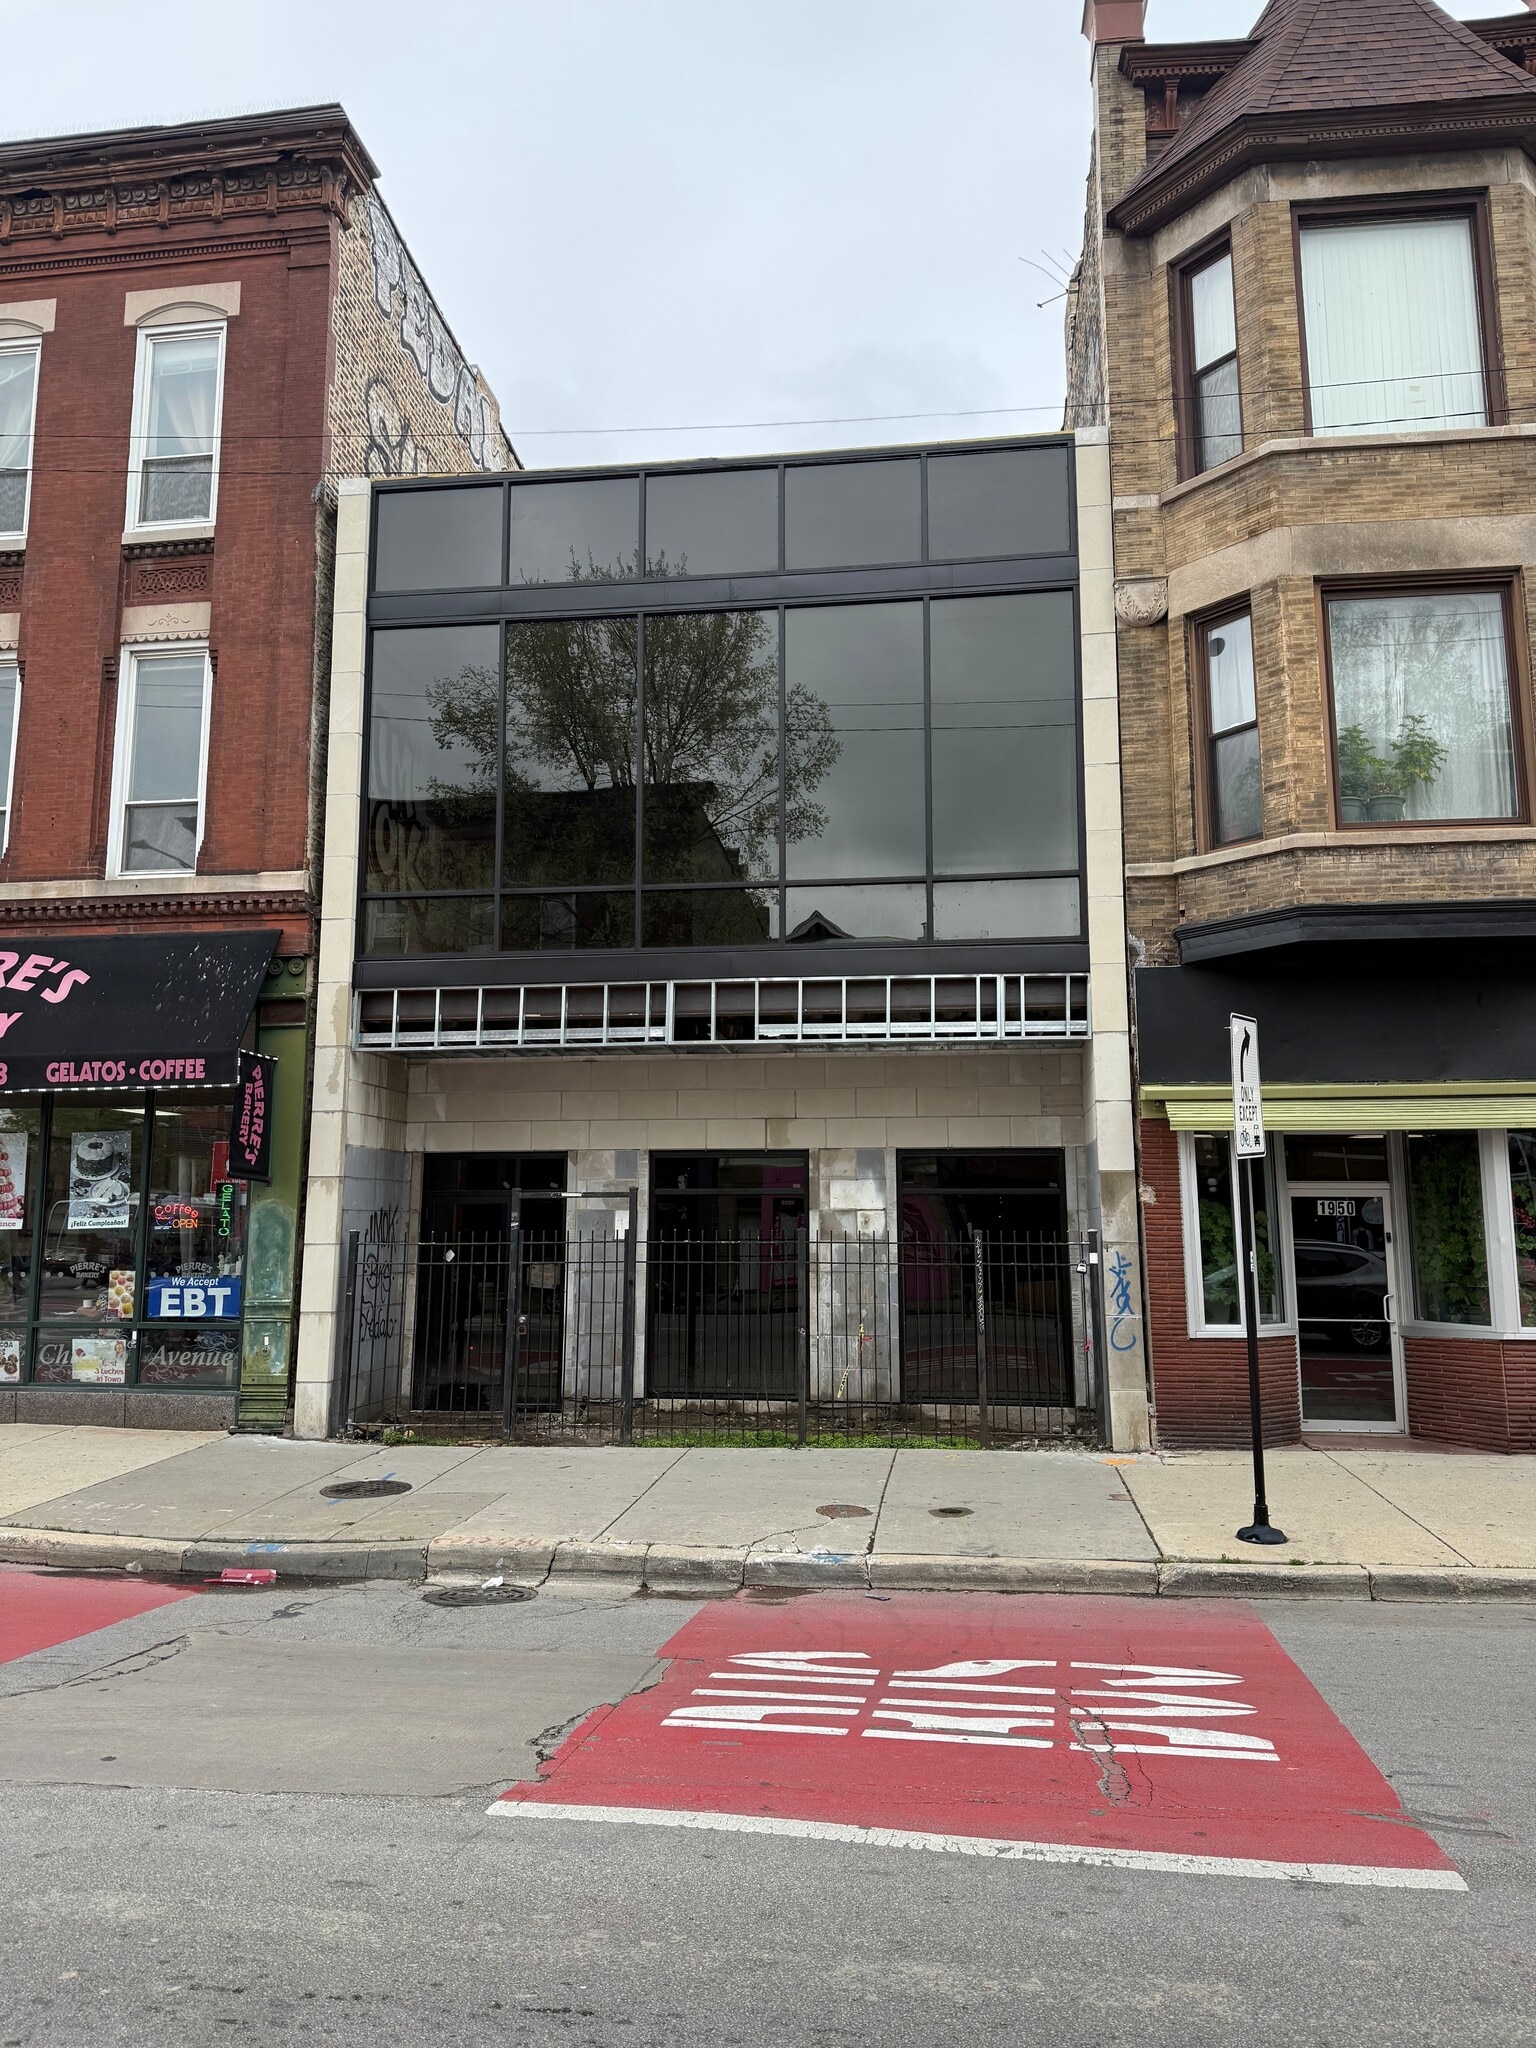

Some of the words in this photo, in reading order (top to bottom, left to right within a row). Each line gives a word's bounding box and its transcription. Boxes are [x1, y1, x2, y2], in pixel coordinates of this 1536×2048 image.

[46, 1060, 126, 1083] GELATOS
[139, 1058, 206, 1081] COFFEE
[1241, 1086, 1254, 1102] ONLY
[239, 1082, 253, 1145] BAKERY
[244, 1064, 265, 1166] PIERRE'S
[1239, 1105, 1257, 1121] EXCEPT
[218, 1184, 233, 1236] GELATO
[1319, 1201, 1354, 1215] 1950
[172, 1218, 198, 1229] OPEN
[70, 1261, 107, 1274] PIERRE'S
[175, 1261, 213, 1274] PIERRE'S
[171, 1277, 185, 1286] We
[186, 1277, 219, 1288] Accept
[159, 1287, 231, 1317] EBT
[149, 1345, 234, 1366] Avenue
[661, 1650, 1281, 1761] BUS
